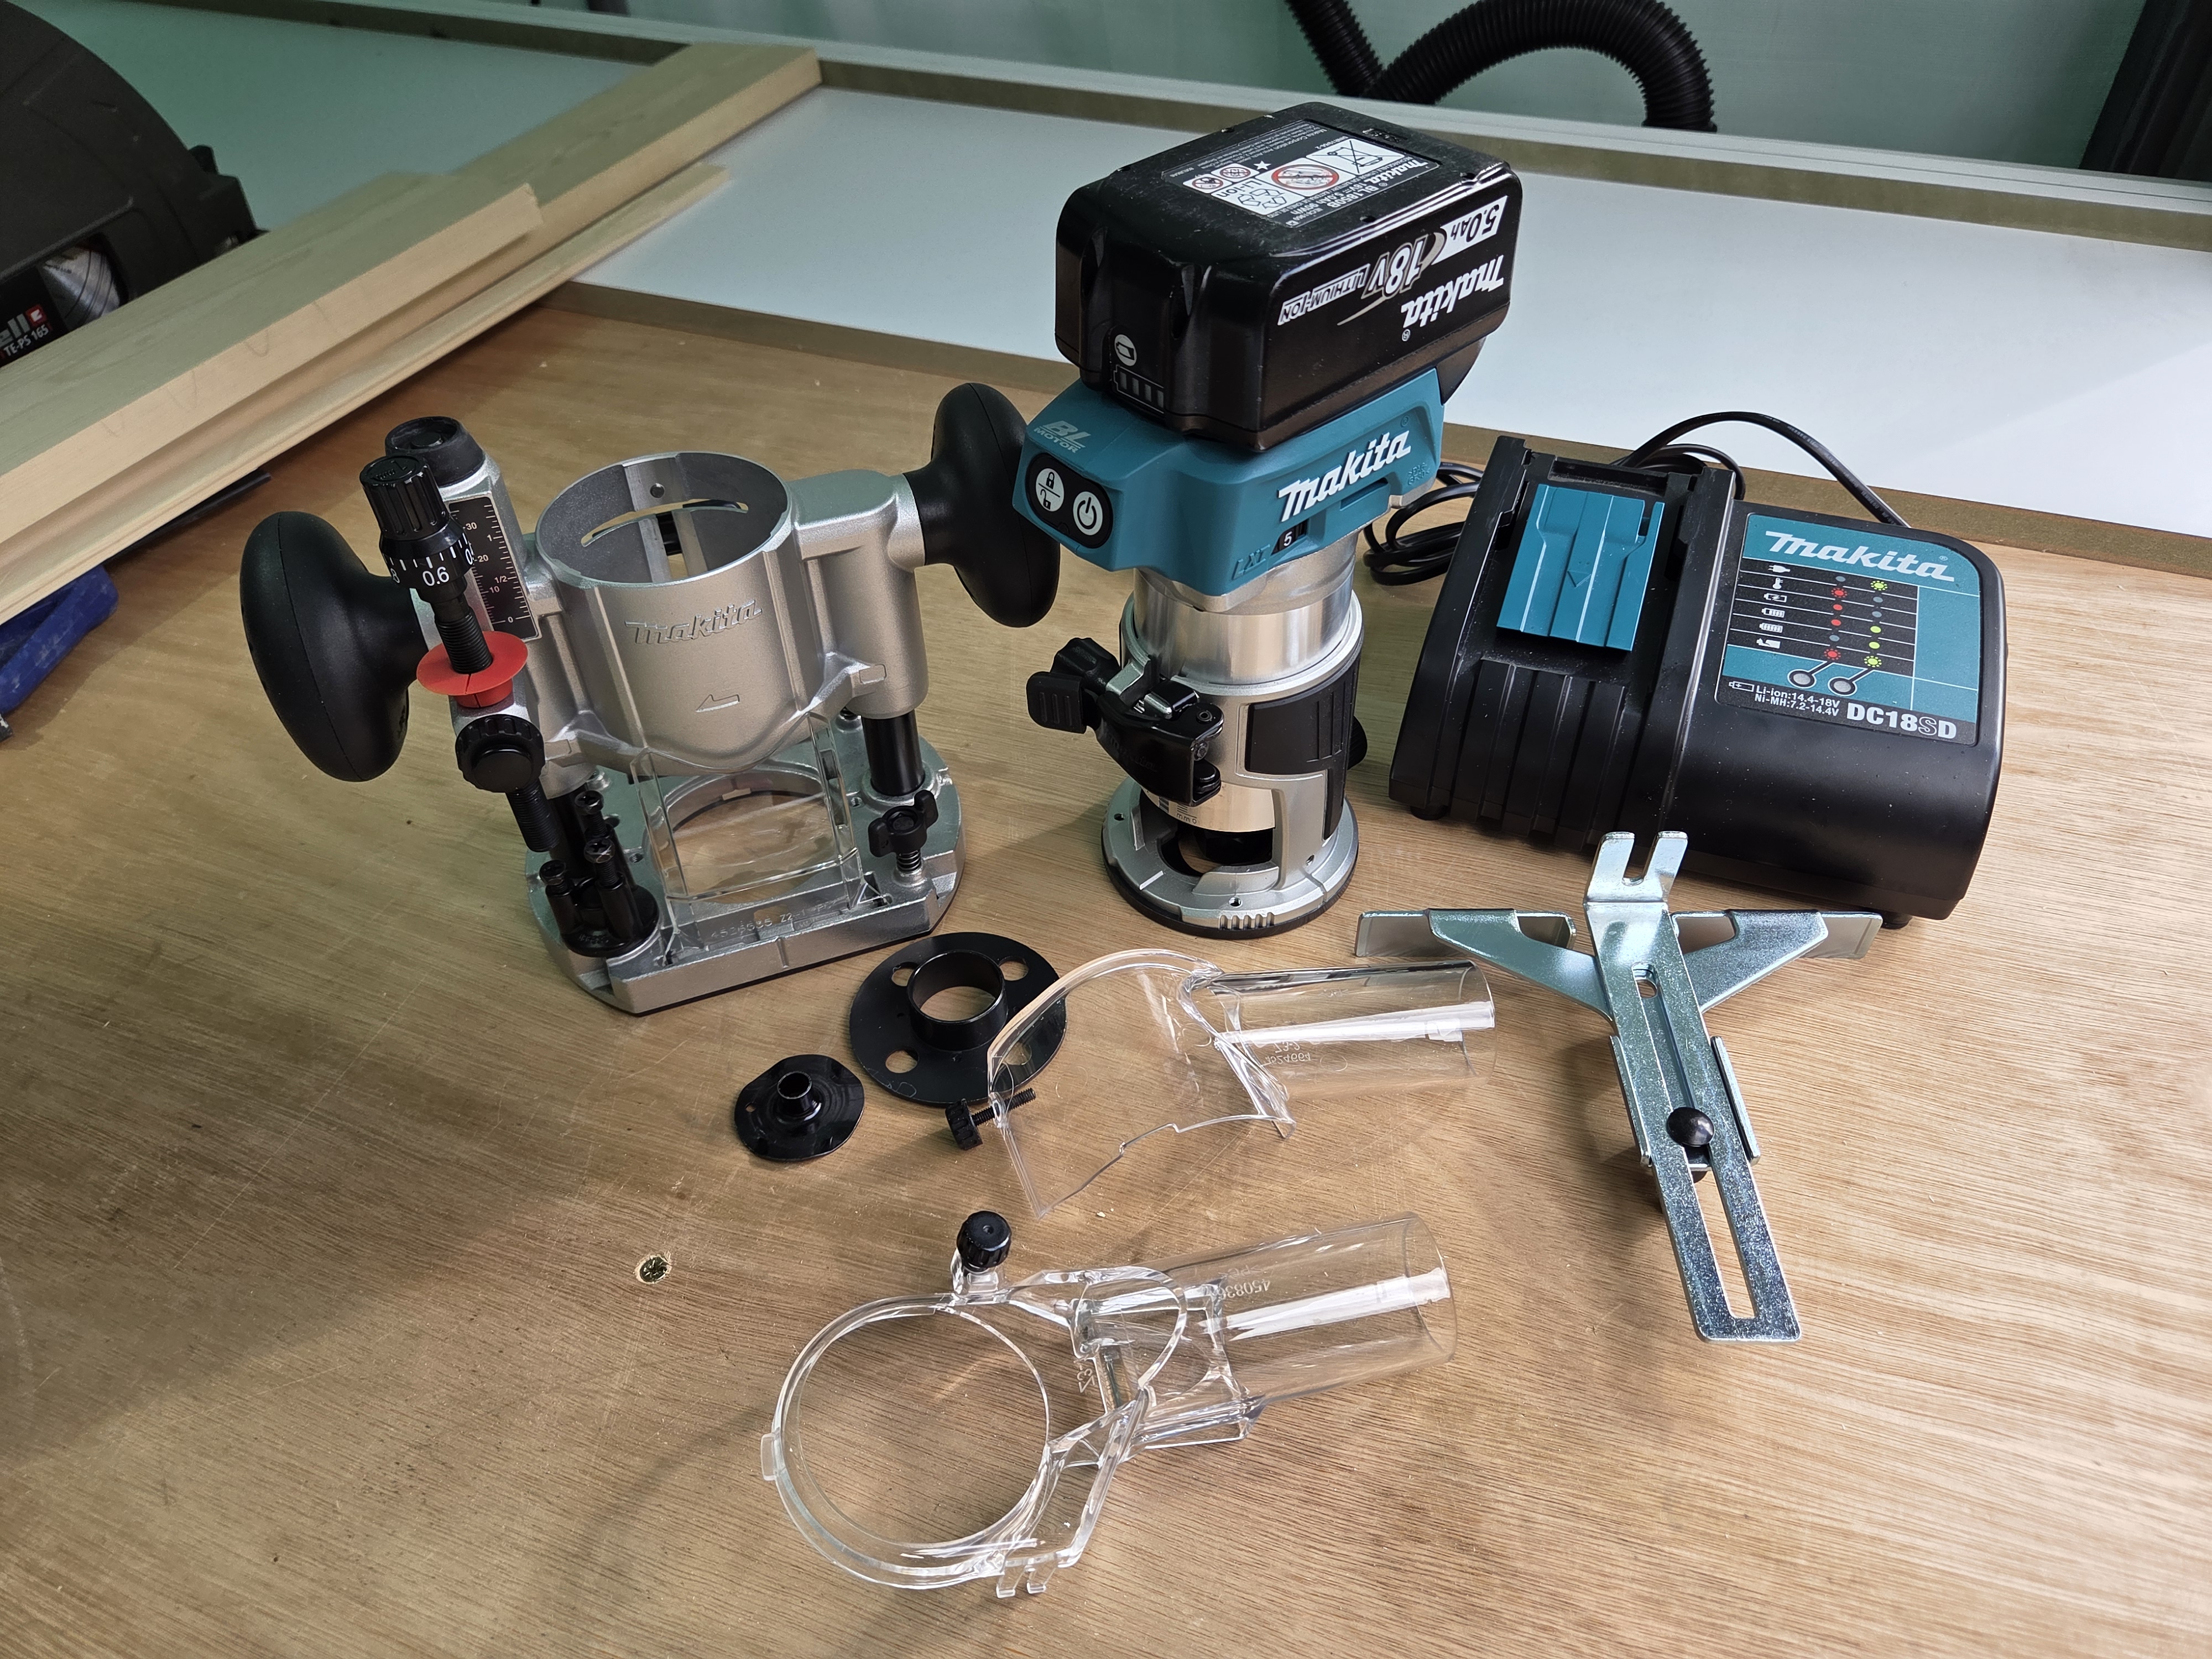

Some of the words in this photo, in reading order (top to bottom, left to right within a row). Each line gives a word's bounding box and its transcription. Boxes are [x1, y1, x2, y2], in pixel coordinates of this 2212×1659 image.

[1362, 158, 1429, 186] makita
[1215, 180, 1262, 199] Li-ion
[1324, 185, 1380, 208] BL1850B
[1346, 182, 1368, 191] 18V
[1288, 202, 1320, 215] 90Wh
[1450, 205, 1499, 242] 5.0Ah
[1365, 236, 1427, 298] 18V
[1278, 264, 1370, 325] LITHIUM-ION
[1400, 254, 1504, 328] makita
[3, 335, 31, 357] TE-PS
[32, 324, 49, 341] 165
[1033, 427, 1078, 453] MOTOR
[1042, 421, 1091, 447] BL
[1278, 430, 1411, 522] makita
[466, 522, 477, 531] 30
[1283, 531, 1293, 546] 5
[1231, 544, 1270, 580] LXT
[1766, 531, 1954, 582] makita
[422, 566, 450, 586] 0.6
[624, 599, 763, 645] makita
[1846, 702, 1957, 739] DC18SD
[1176, 813, 1191, 823] mm
